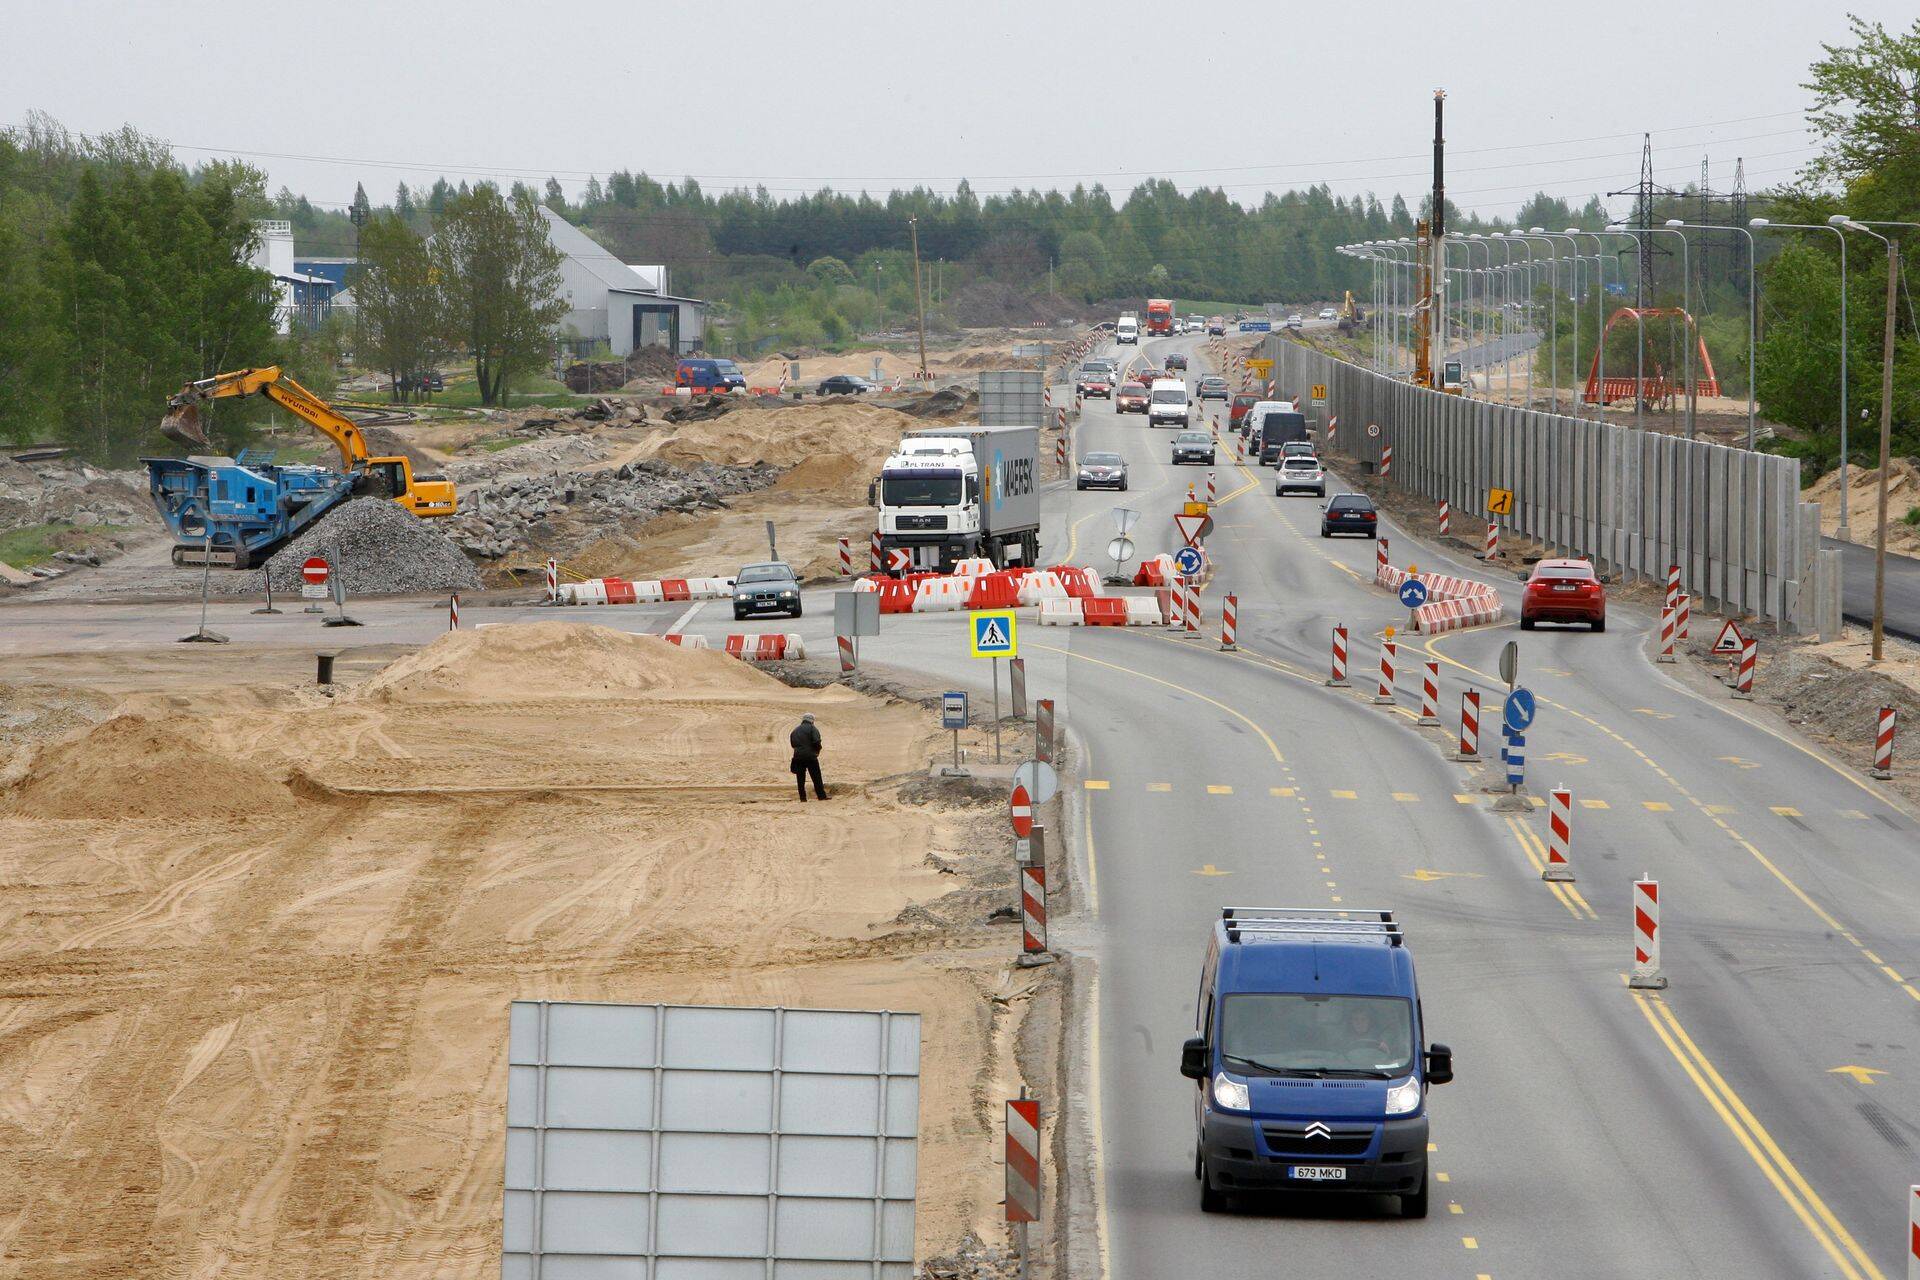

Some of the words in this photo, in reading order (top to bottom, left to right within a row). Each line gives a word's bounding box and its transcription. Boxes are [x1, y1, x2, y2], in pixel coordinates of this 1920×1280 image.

[281, 394, 318, 418] HYUNDAI
[1003, 457, 1034, 497] MAERSK
[1298, 1167, 1316, 1178] 679
[1319, 1168, 1342, 1178] MKD
